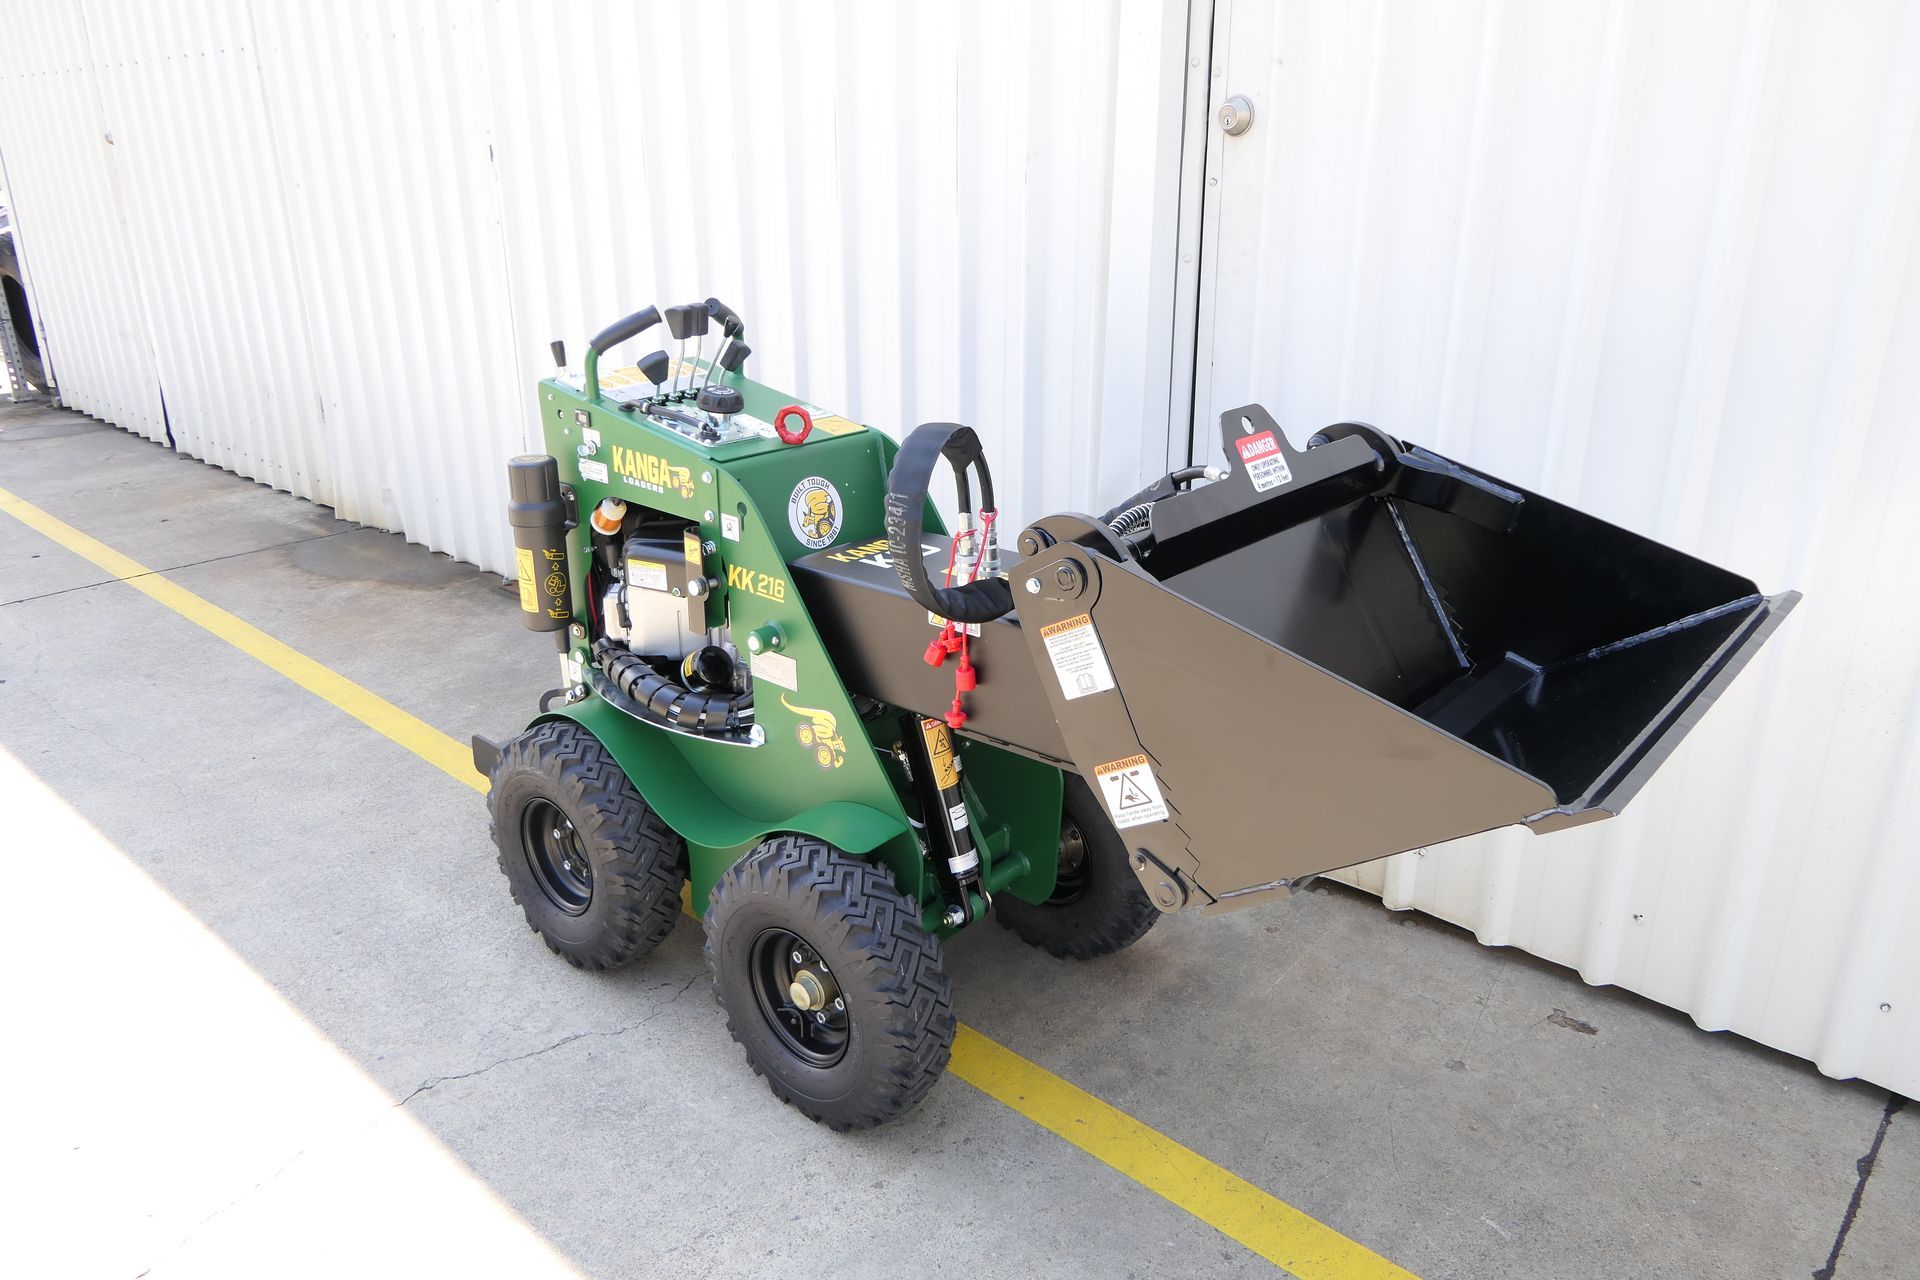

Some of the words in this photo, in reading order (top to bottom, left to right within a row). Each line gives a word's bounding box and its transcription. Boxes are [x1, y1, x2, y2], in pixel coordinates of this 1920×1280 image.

[1247, 437, 1277, 457] DANGER
[612, 445, 672, 488] KANGA
[623, 476, 664, 494] LOADERS
[791, 482, 806, 505] BUILT
[807, 478, 830, 490] TOUGH
[806, 538, 827, 548] SINCE
[827, 526, 839, 541] 1981
[728, 564, 756, 593] KK
[757, 573, 785, 600] 216
[1047, 615, 1089, 636] WARNING
[1102, 755, 1146, 774] WARNING
